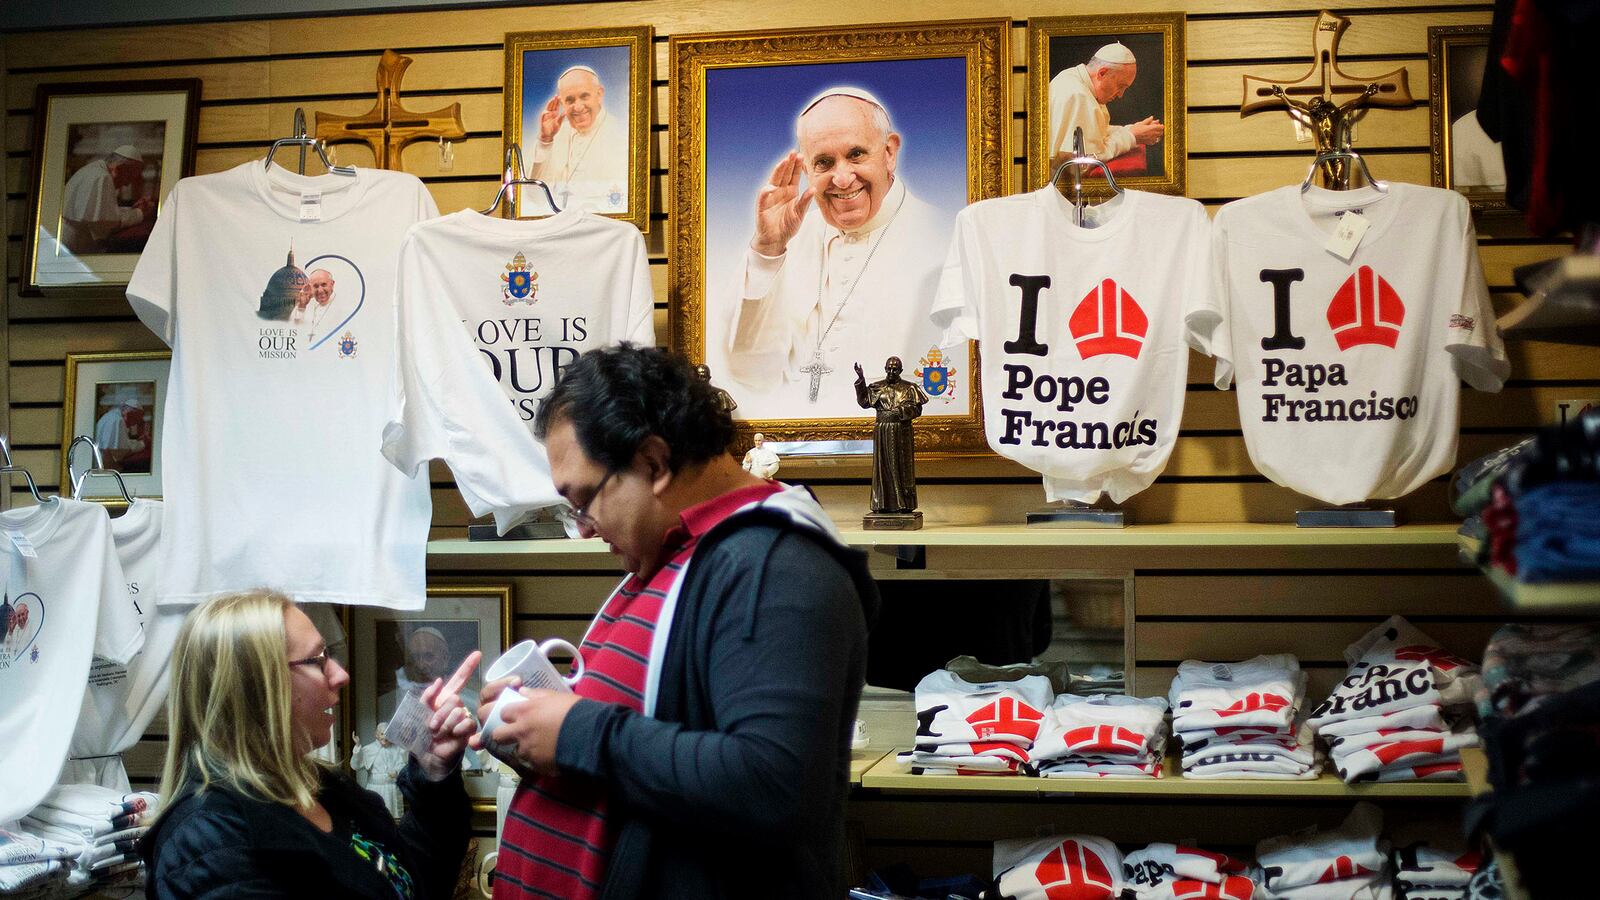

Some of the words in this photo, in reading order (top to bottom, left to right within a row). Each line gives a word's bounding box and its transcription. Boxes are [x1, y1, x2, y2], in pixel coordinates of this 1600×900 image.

[1004, 274, 1051, 357] I
[1259, 268, 1306, 351] I
[258, 336, 297, 351] OUR
[259, 328, 286, 337] LOVE
[289, 328, 298, 337] IS
[462, 317, 543, 345] OVE
[560, 316, 588, 342] IS
[258, 351, 297, 360] MISSION
[1001, 363, 1110, 412] Pope
[1261, 358, 1349, 393] Papa
[1261, 390, 1419, 423] Francisco
[999, 408, 1158, 450] Francis
